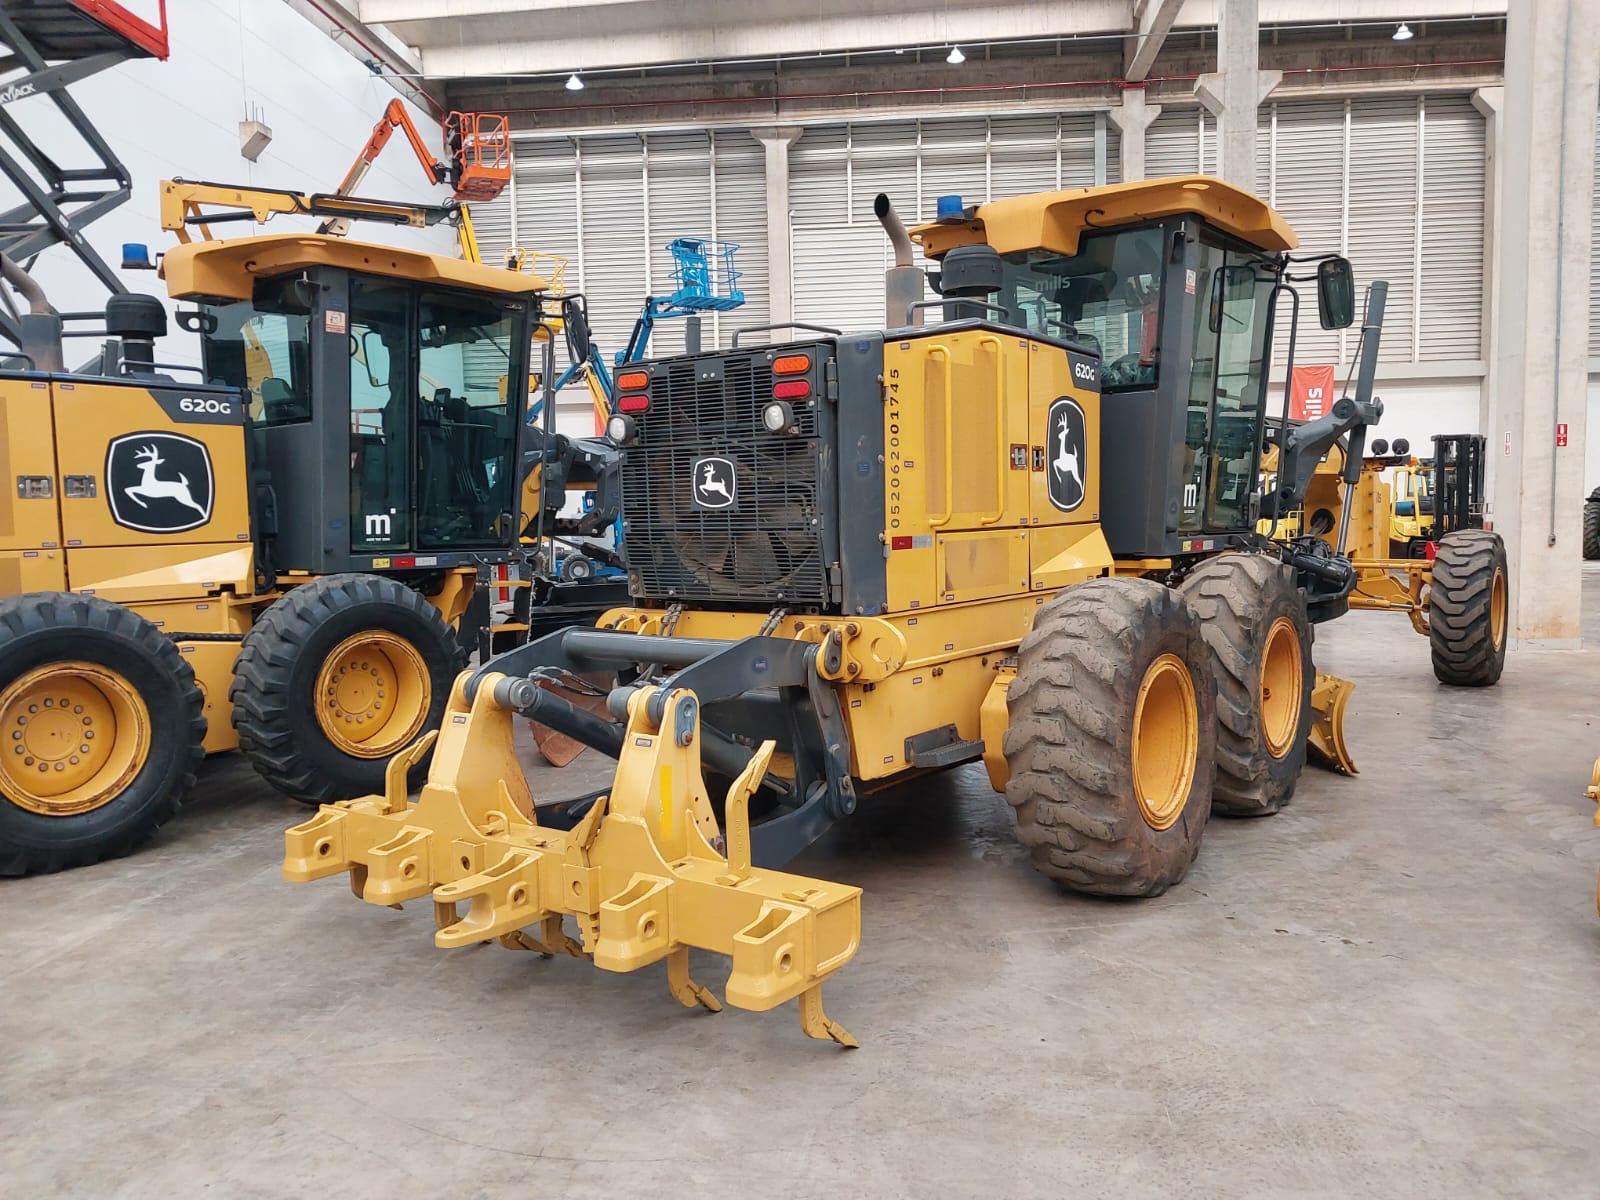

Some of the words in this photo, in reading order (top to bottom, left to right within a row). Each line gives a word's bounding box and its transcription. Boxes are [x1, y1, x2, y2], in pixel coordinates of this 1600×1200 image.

[1035, 274, 1071, 291] mills
[1076, 362, 1095, 381] 620G
[179, 397, 231, 414] 620G
[890, 369, 900, 528] 052062001745
